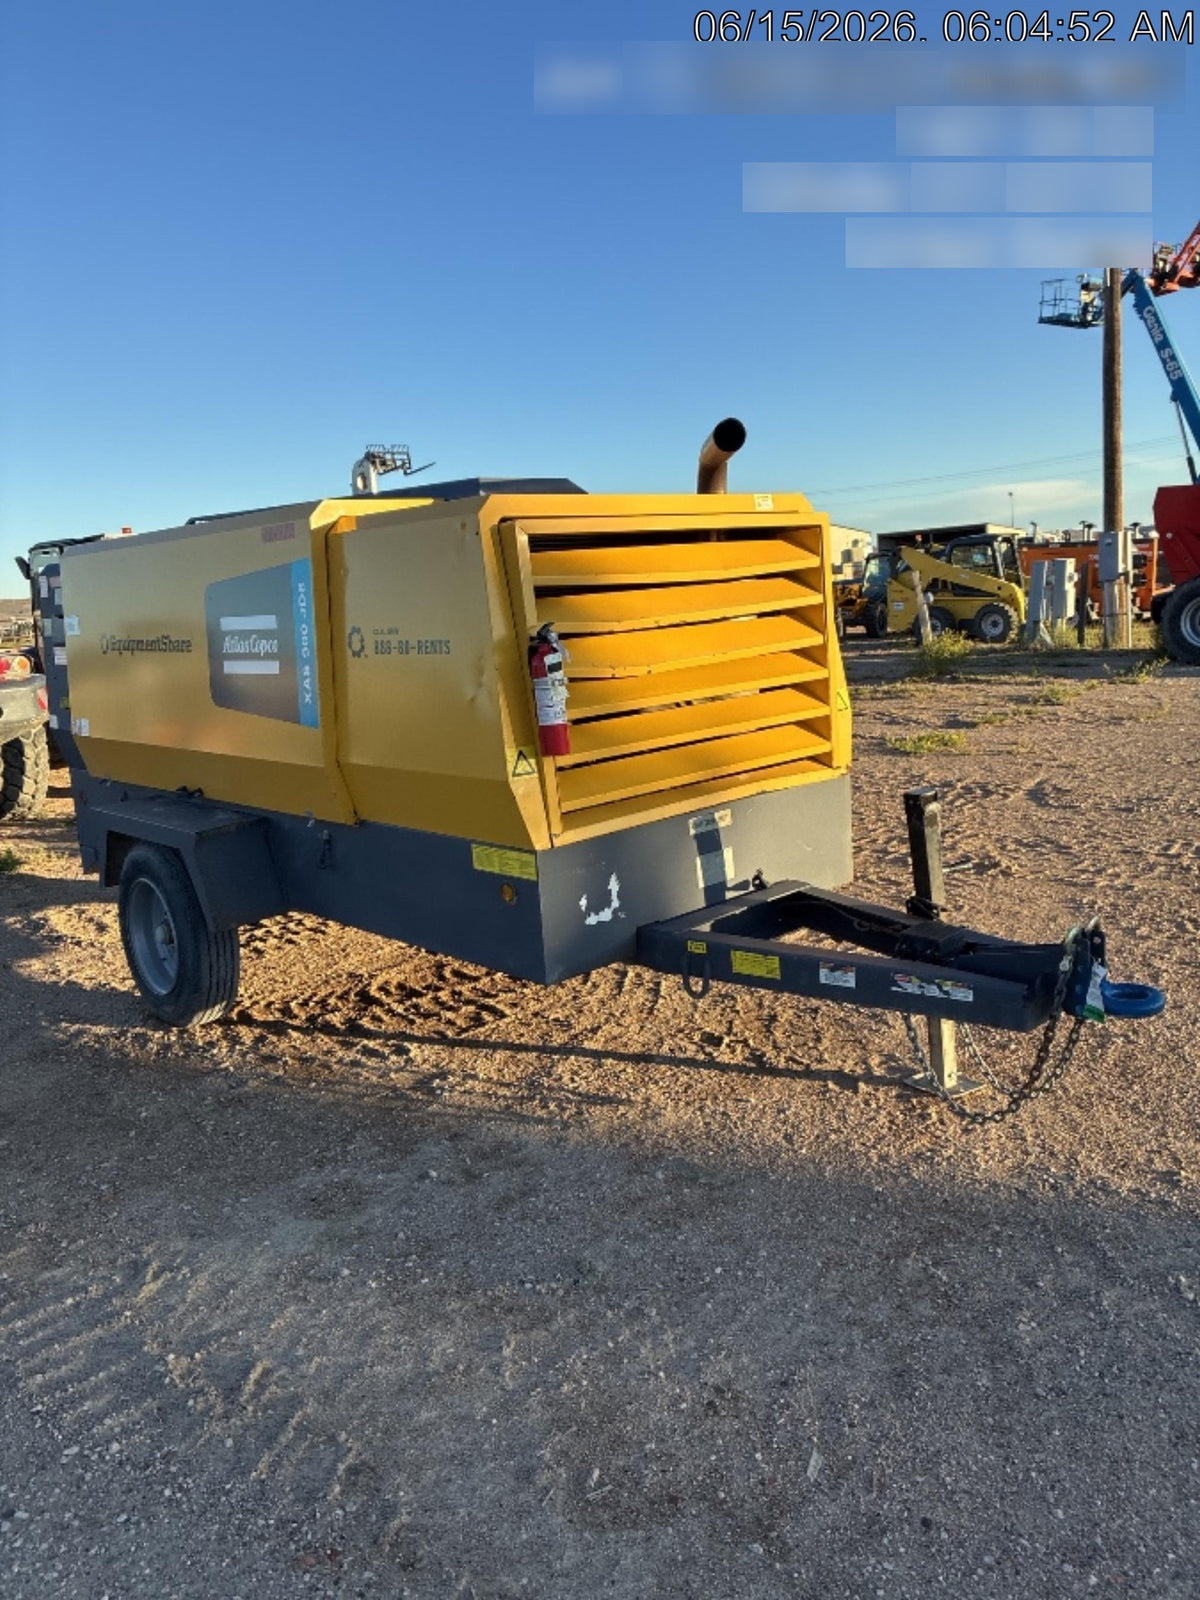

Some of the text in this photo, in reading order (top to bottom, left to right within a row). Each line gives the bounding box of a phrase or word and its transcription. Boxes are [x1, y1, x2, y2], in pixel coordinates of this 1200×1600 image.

[1142, 305, 1184, 380] Genie S-65
[110, 634, 193, 656] EquipmentShare
[222, 634, 250, 654] Atlas
